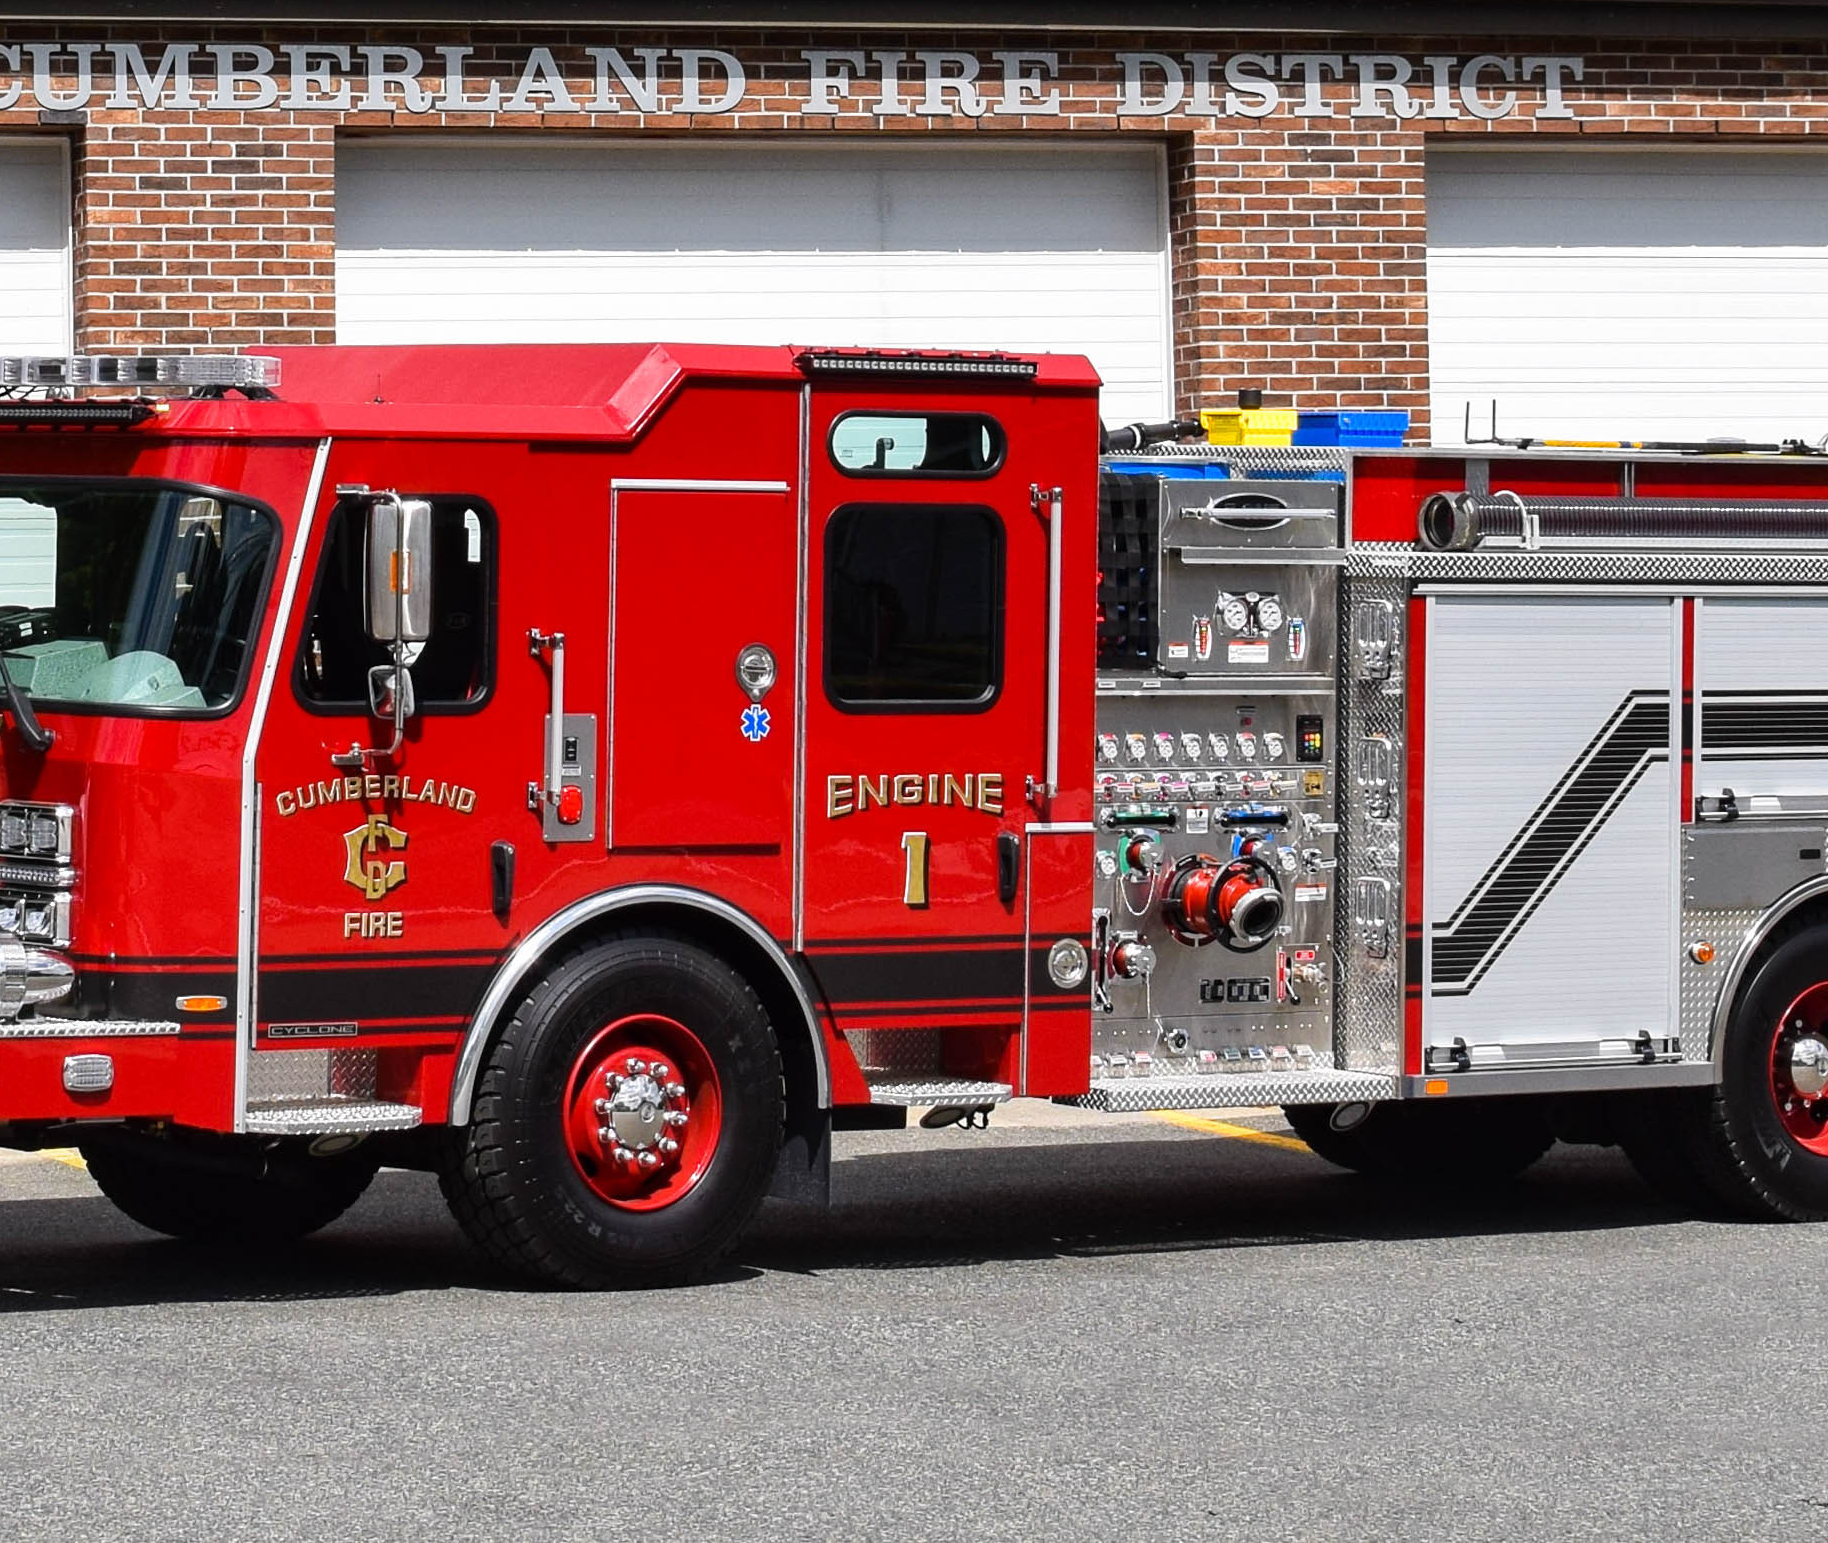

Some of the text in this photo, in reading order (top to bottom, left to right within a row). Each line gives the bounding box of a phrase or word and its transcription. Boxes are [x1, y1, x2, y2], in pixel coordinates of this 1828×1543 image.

[801, 49, 1060, 116] FIRE
[1116, 51, 1586, 120] DISTRICT
[276, 775, 477, 817] CUMBERLAND
[827, 773, 1004, 819] ENGINE
[901, 831, 928, 905] 1
[344, 912, 404, 938] FIRE
[271, 1025, 355, 1035] CYCLONE
